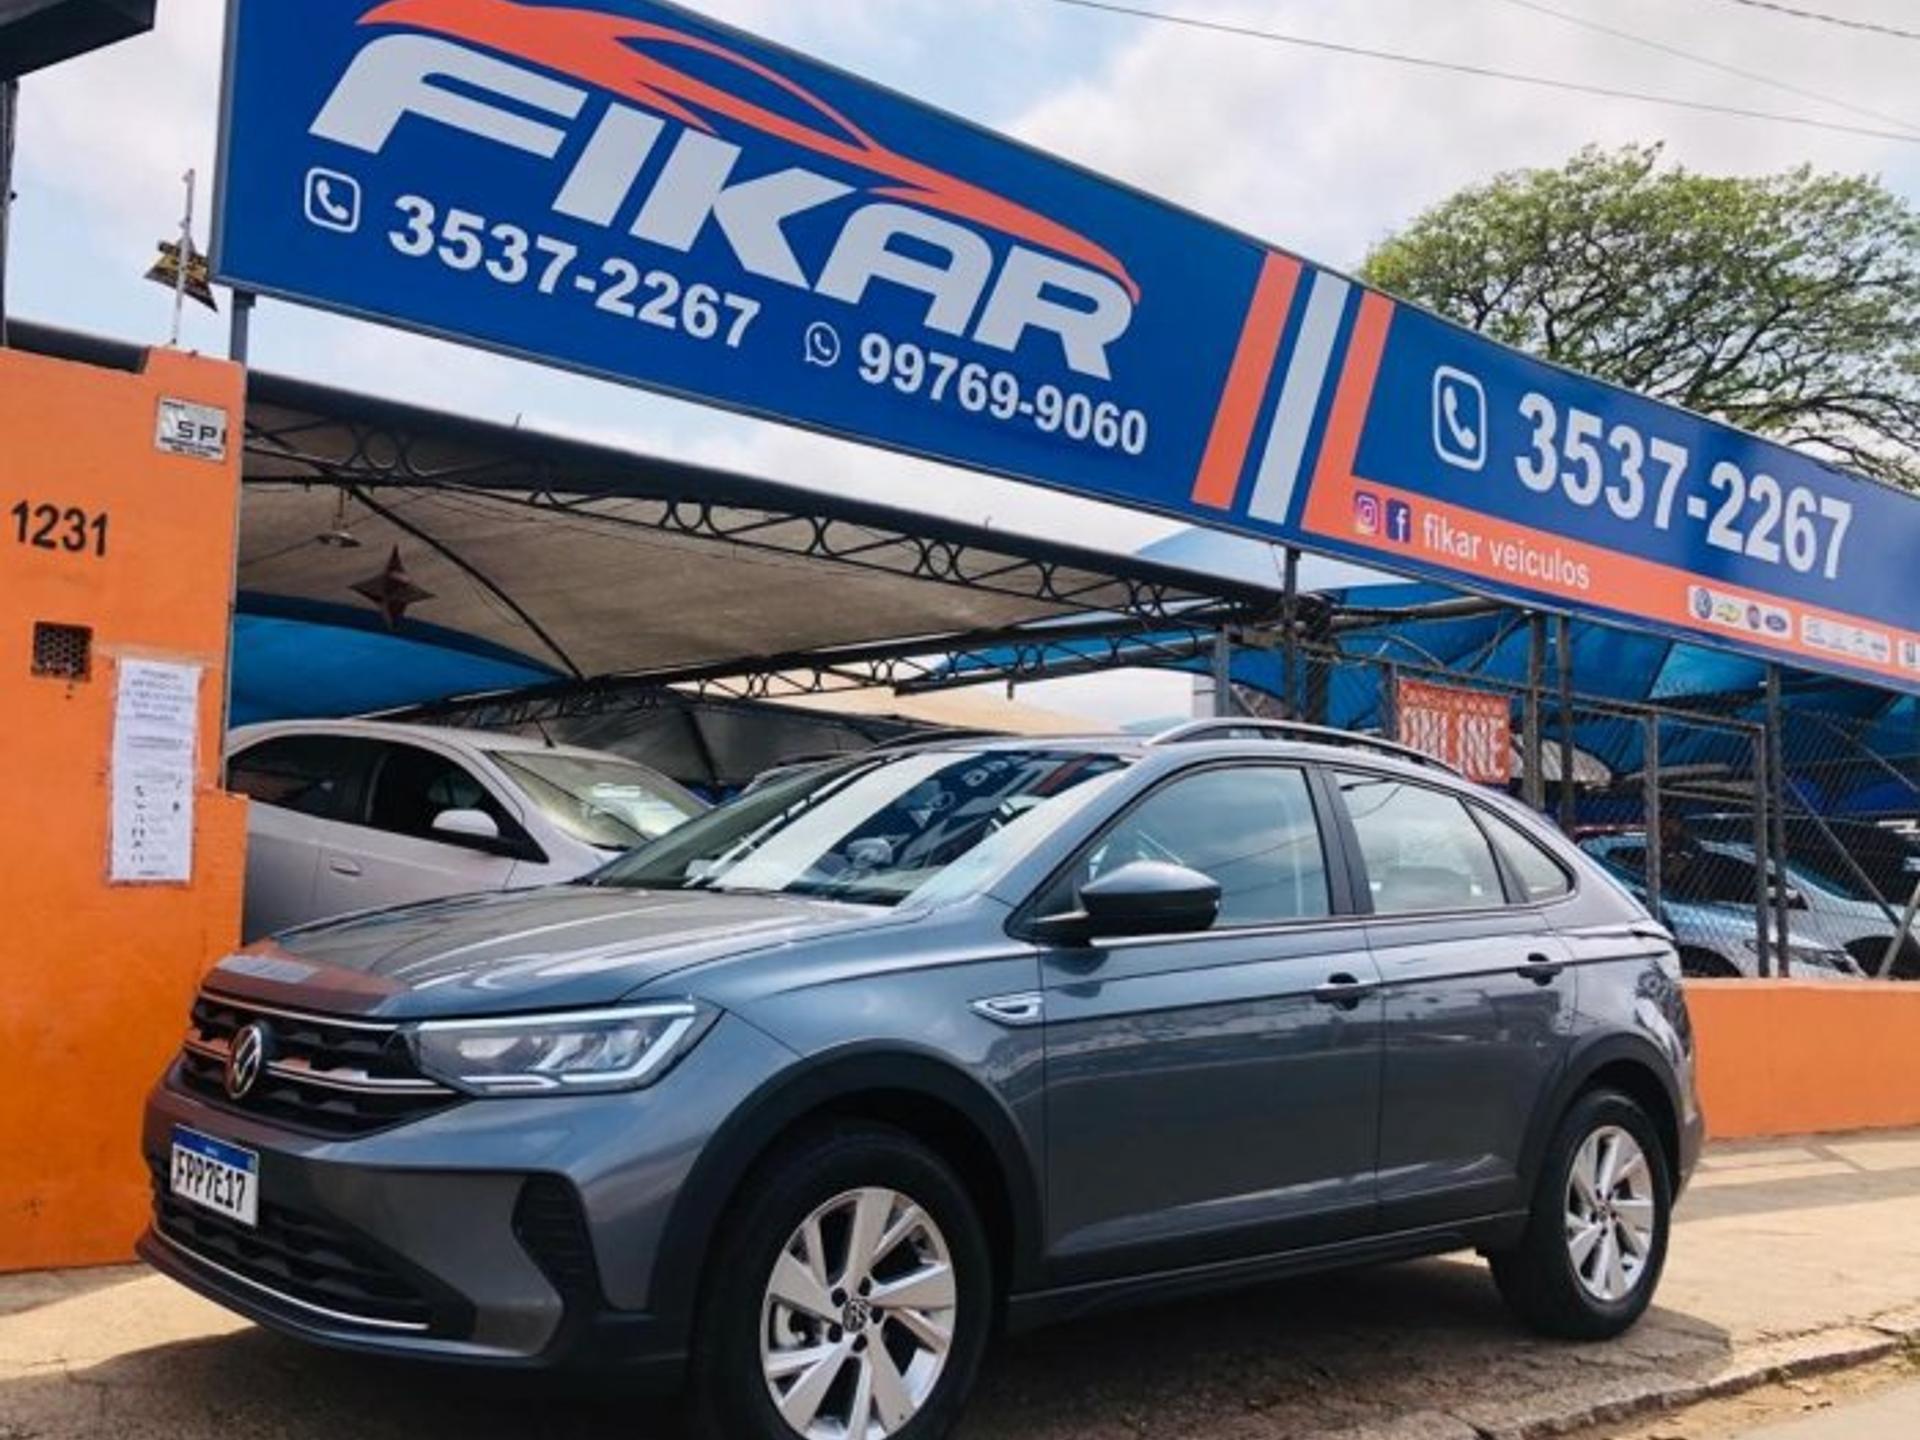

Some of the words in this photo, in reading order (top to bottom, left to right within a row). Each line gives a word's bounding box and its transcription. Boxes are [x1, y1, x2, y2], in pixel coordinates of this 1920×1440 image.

[308, 33, 1133, 381] FIKAR
[387, 195, 761, 348] 3537-2267
[857, 332, 1148, 455] 99769-9060
[11, 500, 108, 557] 1231
[1423, 513, 1482, 560] fikar
[1488, 537, 1590, 589] veiculos
[1514, 392, 1853, 579] 3537-2267
